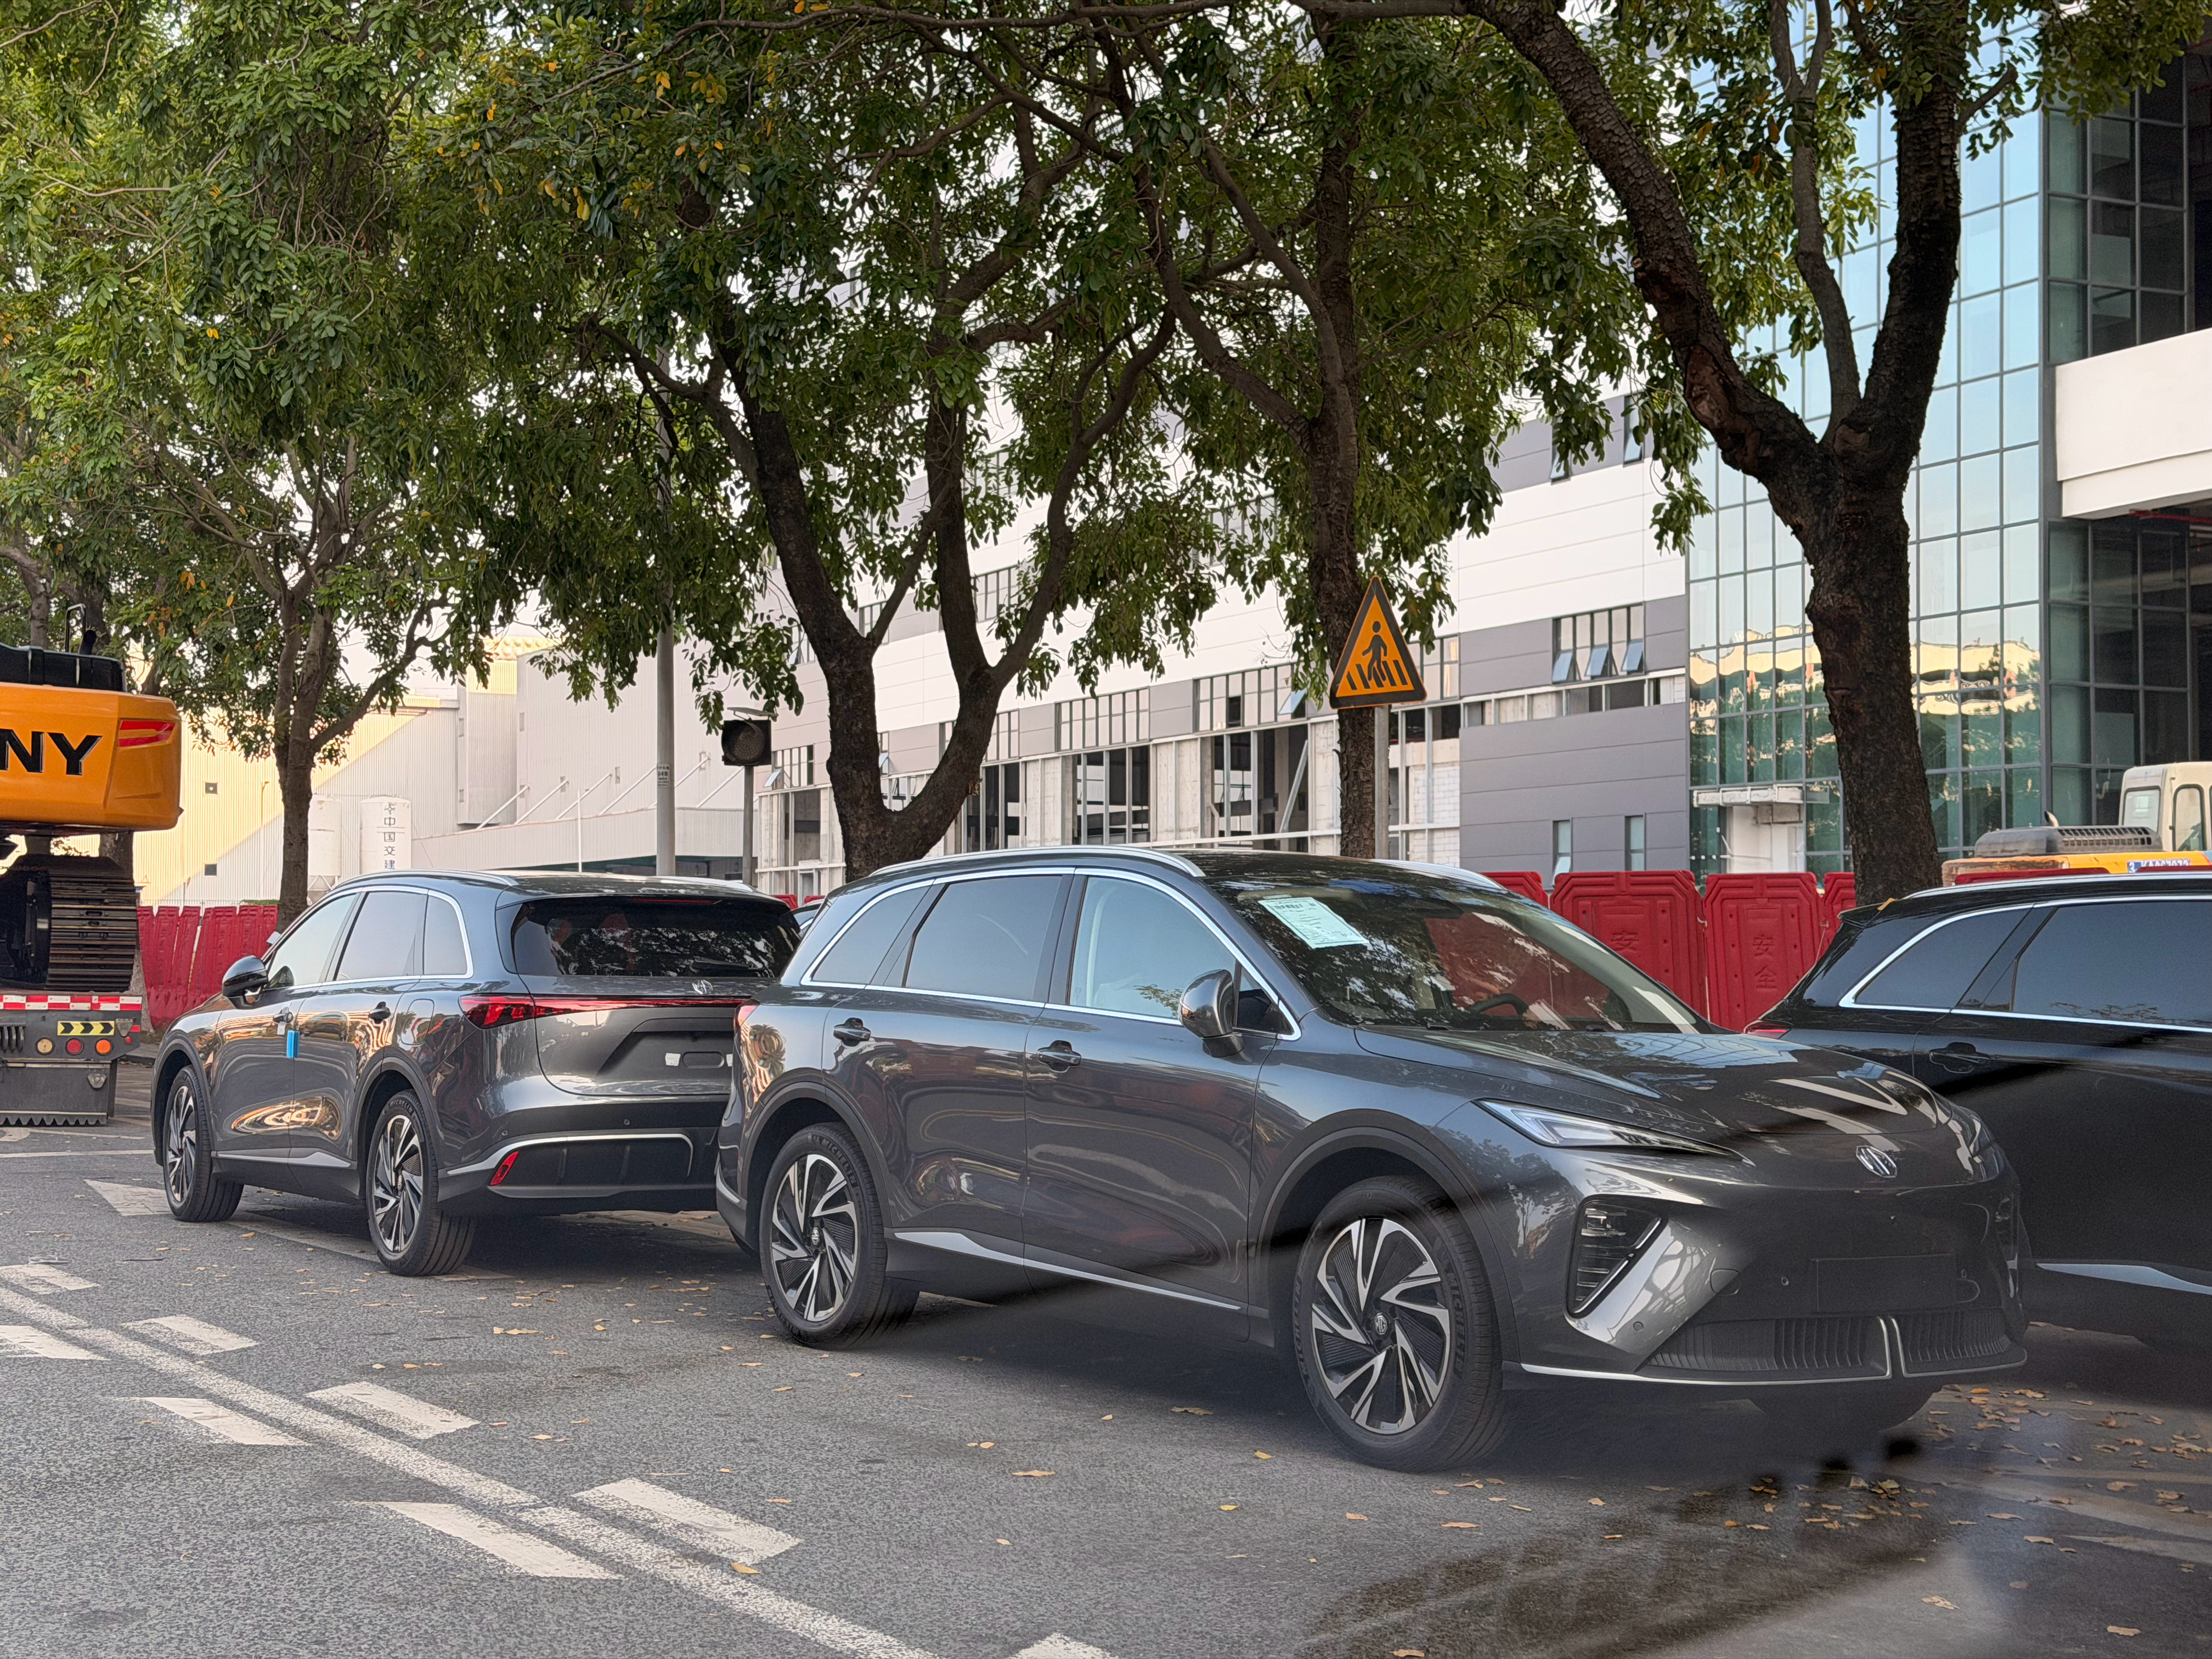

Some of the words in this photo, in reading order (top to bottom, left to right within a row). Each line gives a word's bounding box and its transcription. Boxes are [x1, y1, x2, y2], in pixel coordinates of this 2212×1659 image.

[0, 729, 103, 776] NY
[383, 816, 396, 870] 中国交建
[1752, 934, 1778, 990] 安全
[389, 1098, 413, 1114] MICHELIN
[821, 1137, 859, 1186] MICHELIN
[1446, 1271, 1465, 1375] MICHELIN
